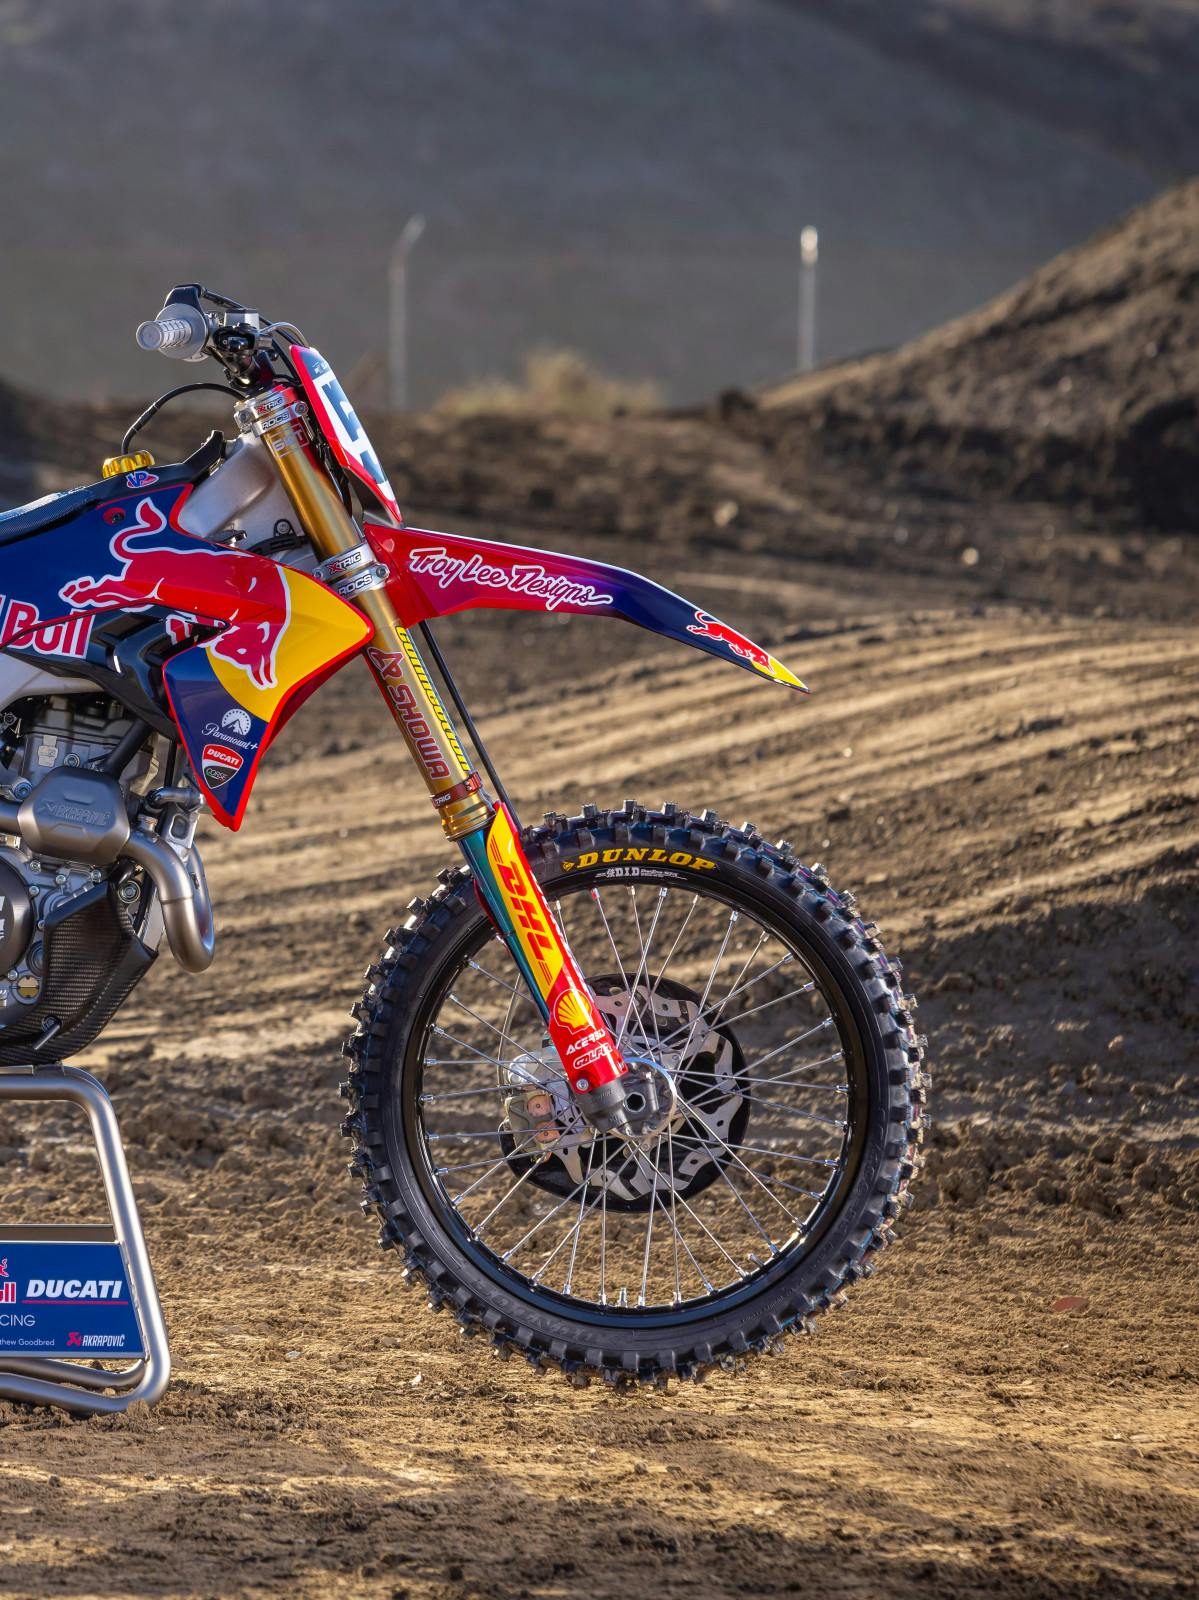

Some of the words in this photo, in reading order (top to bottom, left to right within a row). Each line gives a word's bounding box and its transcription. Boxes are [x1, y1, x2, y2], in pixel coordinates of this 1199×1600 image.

[127, 471, 150, 488] VP
[327, 551, 362, 574] XTRIG
[338, 573, 373, 595] ROCS
[408, 546, 463, 588] Troy
[459, 554, 509, 587] Lee
[507, 564, 613, 611] Designs
[0, 599, 95, 659] Bull
[202, 722, 259, 750] Paramount+
[387, 684, 452, 780] SHOWA
[207, 749, 240, 765] DUCATI
[576, 848, 716, 871] DUNLOP
[497, 861, 553, 961] DHL
[26, 1279, 123, 1299] DUCATI
[19, 1338, 55, 1346] Goodbred
